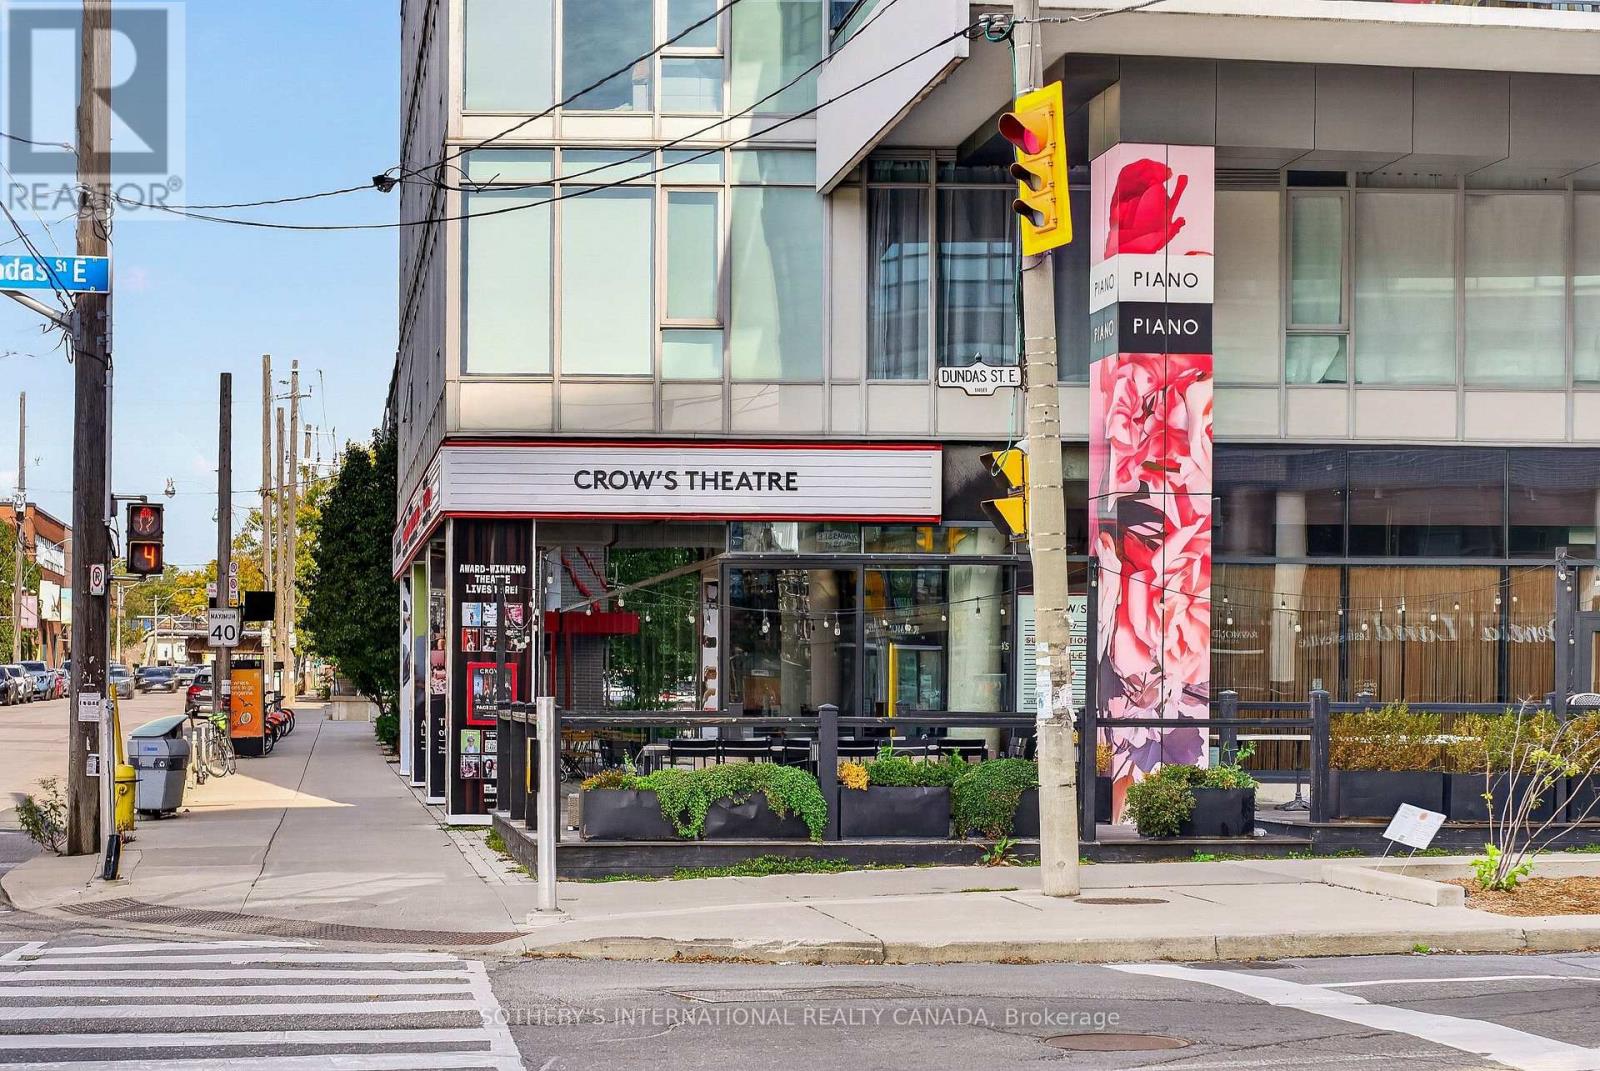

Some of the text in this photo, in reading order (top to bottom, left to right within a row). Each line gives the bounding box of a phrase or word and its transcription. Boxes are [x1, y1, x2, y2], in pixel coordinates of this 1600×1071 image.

[55, 259, 67, 273] St
[73, 260, 87, 283] E
[1133, 271, 1199, 288] PIANO
[1094, 273, 1115, 298] PIANO
[1094, 319, 1114, 343] PIANO
[1133, 318, 1199, 335] PIANO
[942, 369, 1019, 383] DUNDAS ST. E.
[573, 469, 799, 491] CROW'S THEATRE
[144, 546, 155, 567] 4
[459, 564, 527, 574] AWARD-WINNING
[474, 574, 511, 584] THEAE
[465, 584, 492, 594] LIVES
[210, 624, 236, 641] 40
